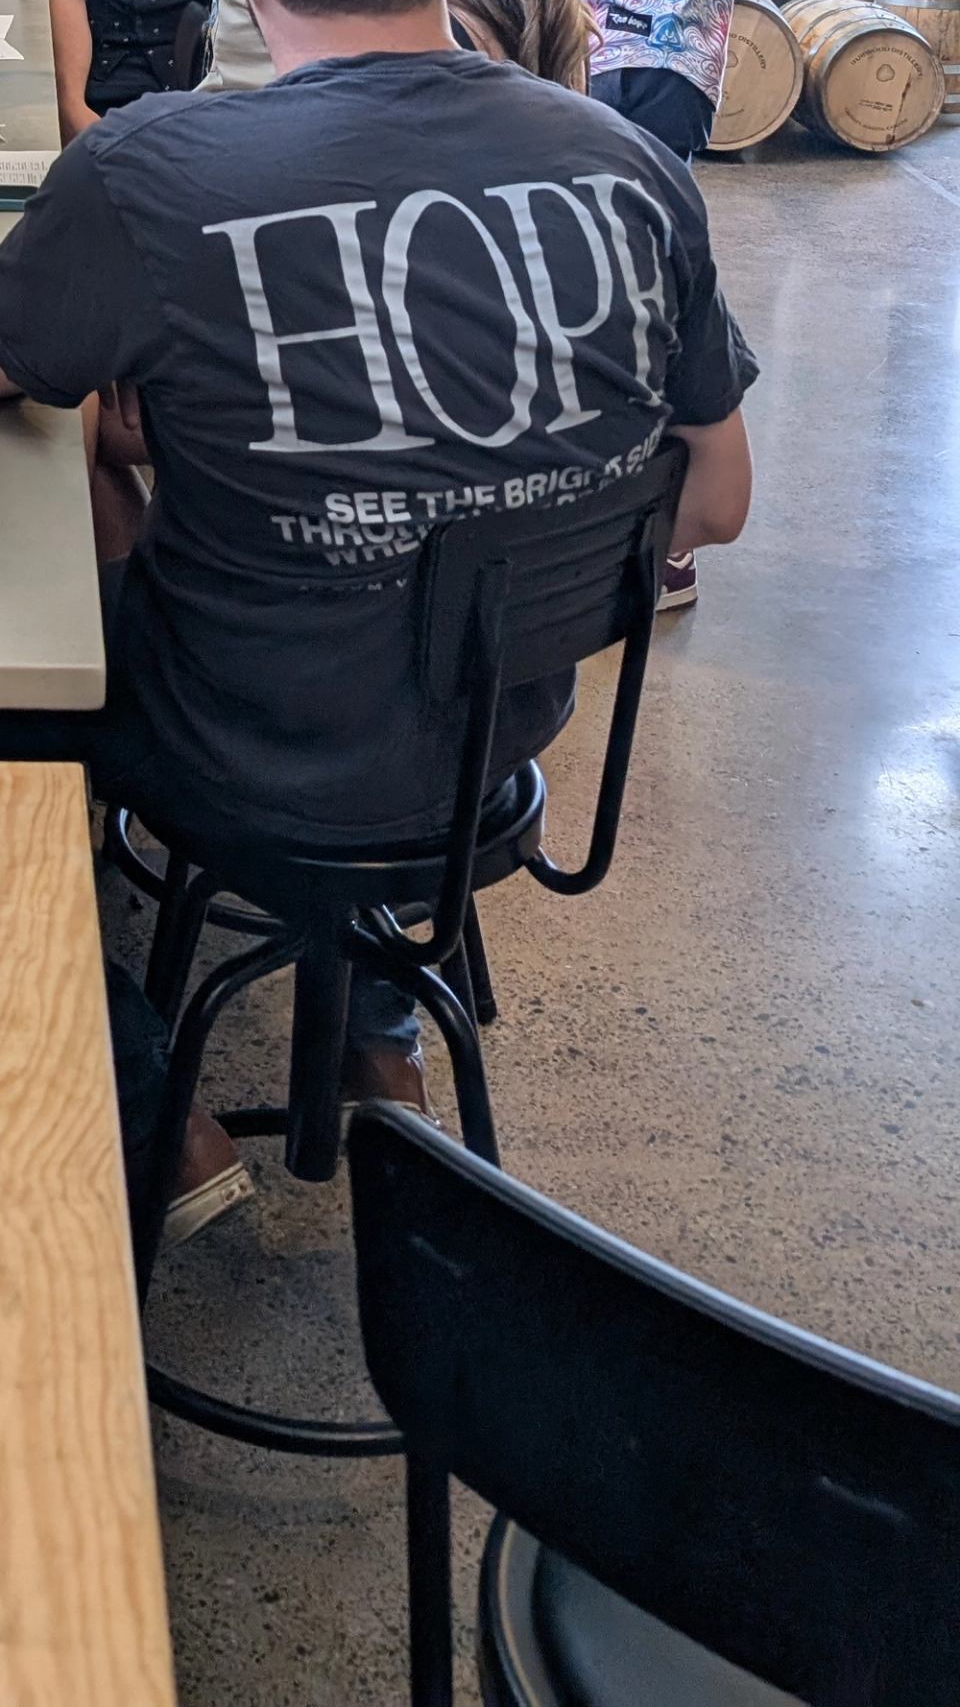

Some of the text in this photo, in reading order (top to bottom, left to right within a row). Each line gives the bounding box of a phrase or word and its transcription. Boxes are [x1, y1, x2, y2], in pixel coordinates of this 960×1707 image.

[325, 491, 412, 525] SEE
[417, 484, 496, 519] THE
[503, 455, 623, 510] BRIGT
